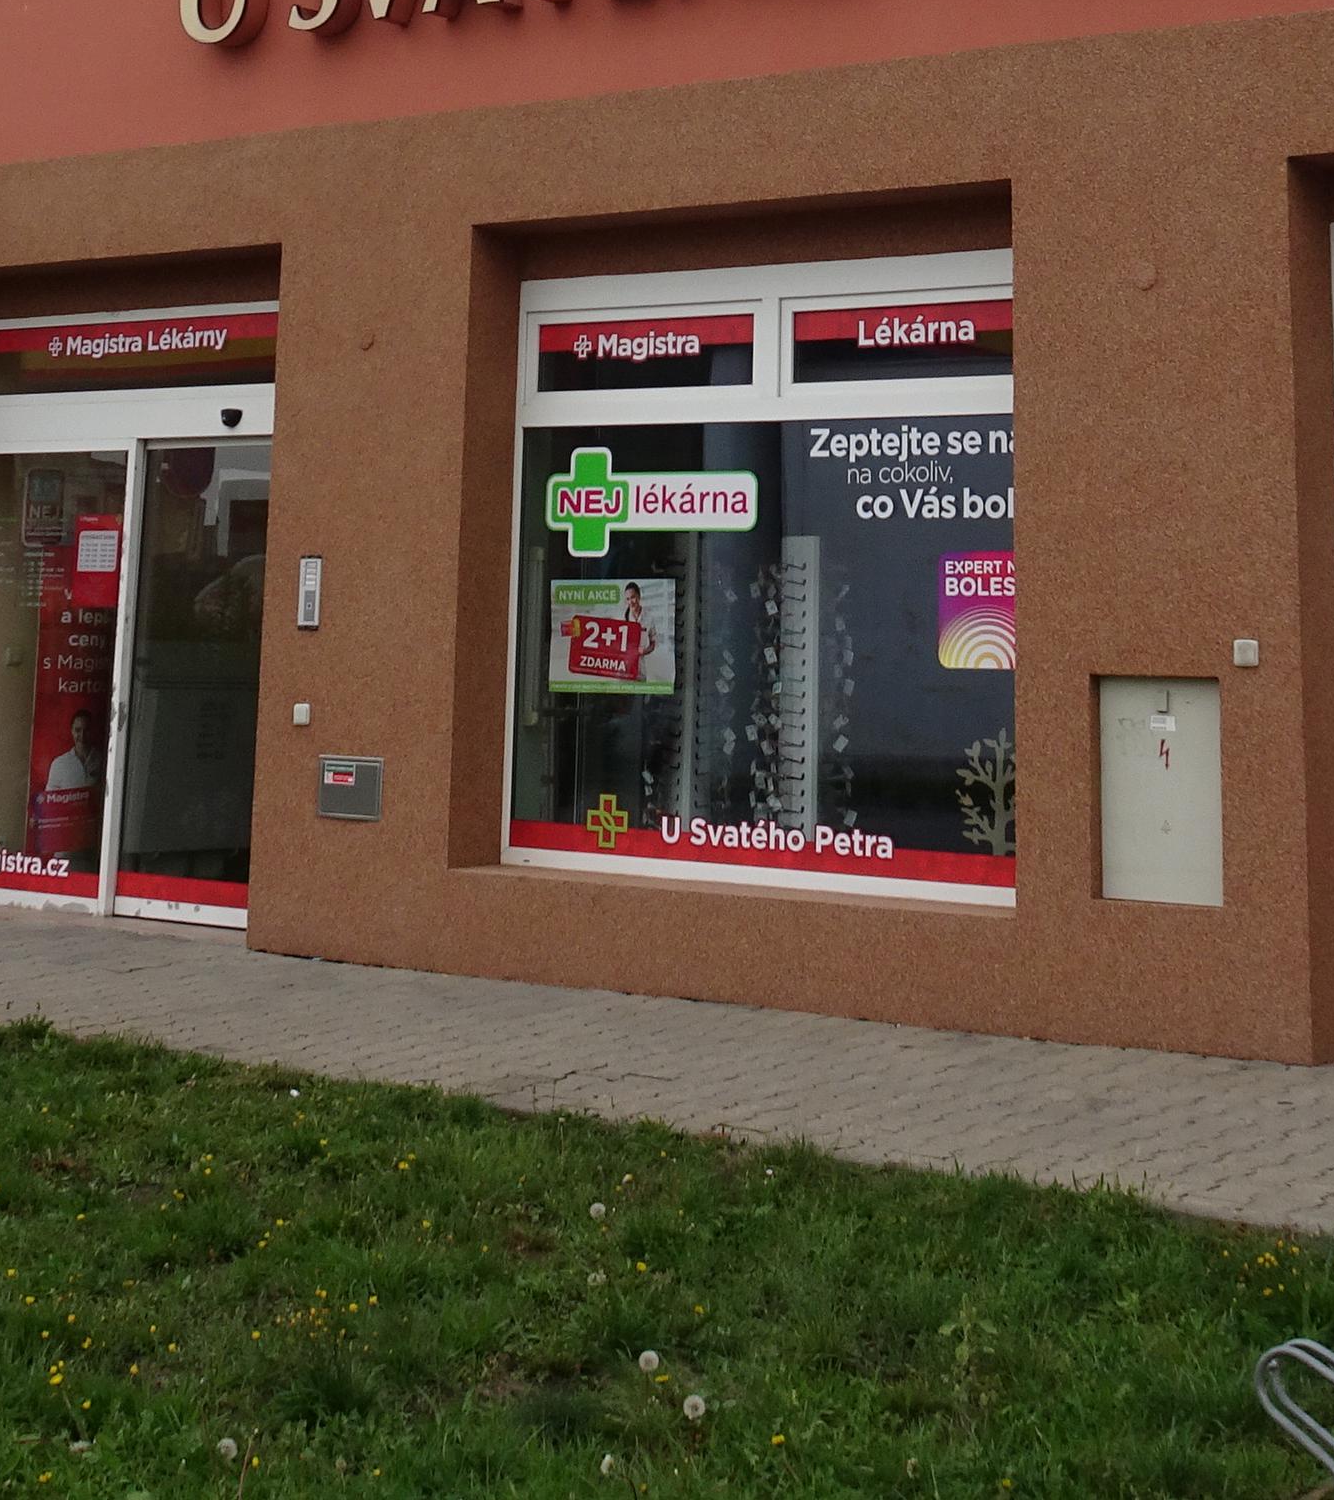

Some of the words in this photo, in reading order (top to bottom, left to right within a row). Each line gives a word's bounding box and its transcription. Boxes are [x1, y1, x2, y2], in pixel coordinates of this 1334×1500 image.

[66, 333, 143, 359] Magistra
[147, 326, 228, 352] Lékárny
[596, 332, 701, 362] Magistra
[857, 314, 976, 348] Lékárna
[809, 425, 941, 463] Zeptejte
[946, 429, 983, 455] se
[847, 467, 872, 484] na
[878, 460, 954, 484] cokoliv,
[558, 488, 624, 515] NEJ
[635, 484, 749, 515] lékárna
[856, 494, 895, 519] co
[899, 486, 957, 519] Vás
[962, 487, 1014, 519] bol
[945, 560, 1003, 574] EXPERT
[558, 587, 585, 600] NYNÍ
[588, 590, 617, 600] AKCE
[945, 576, 1015, 596] BOLES
[60, 611, 72, 623] a
[583, 621, 629, 652] 2+1
[43, 657, 51, 669] s
[579, 655, 626, 671] ZDARMA
[660, 816, 682, 843] U
[690, 818, 806, 853] Svatého
[814, 825, 894, 859] Petra
